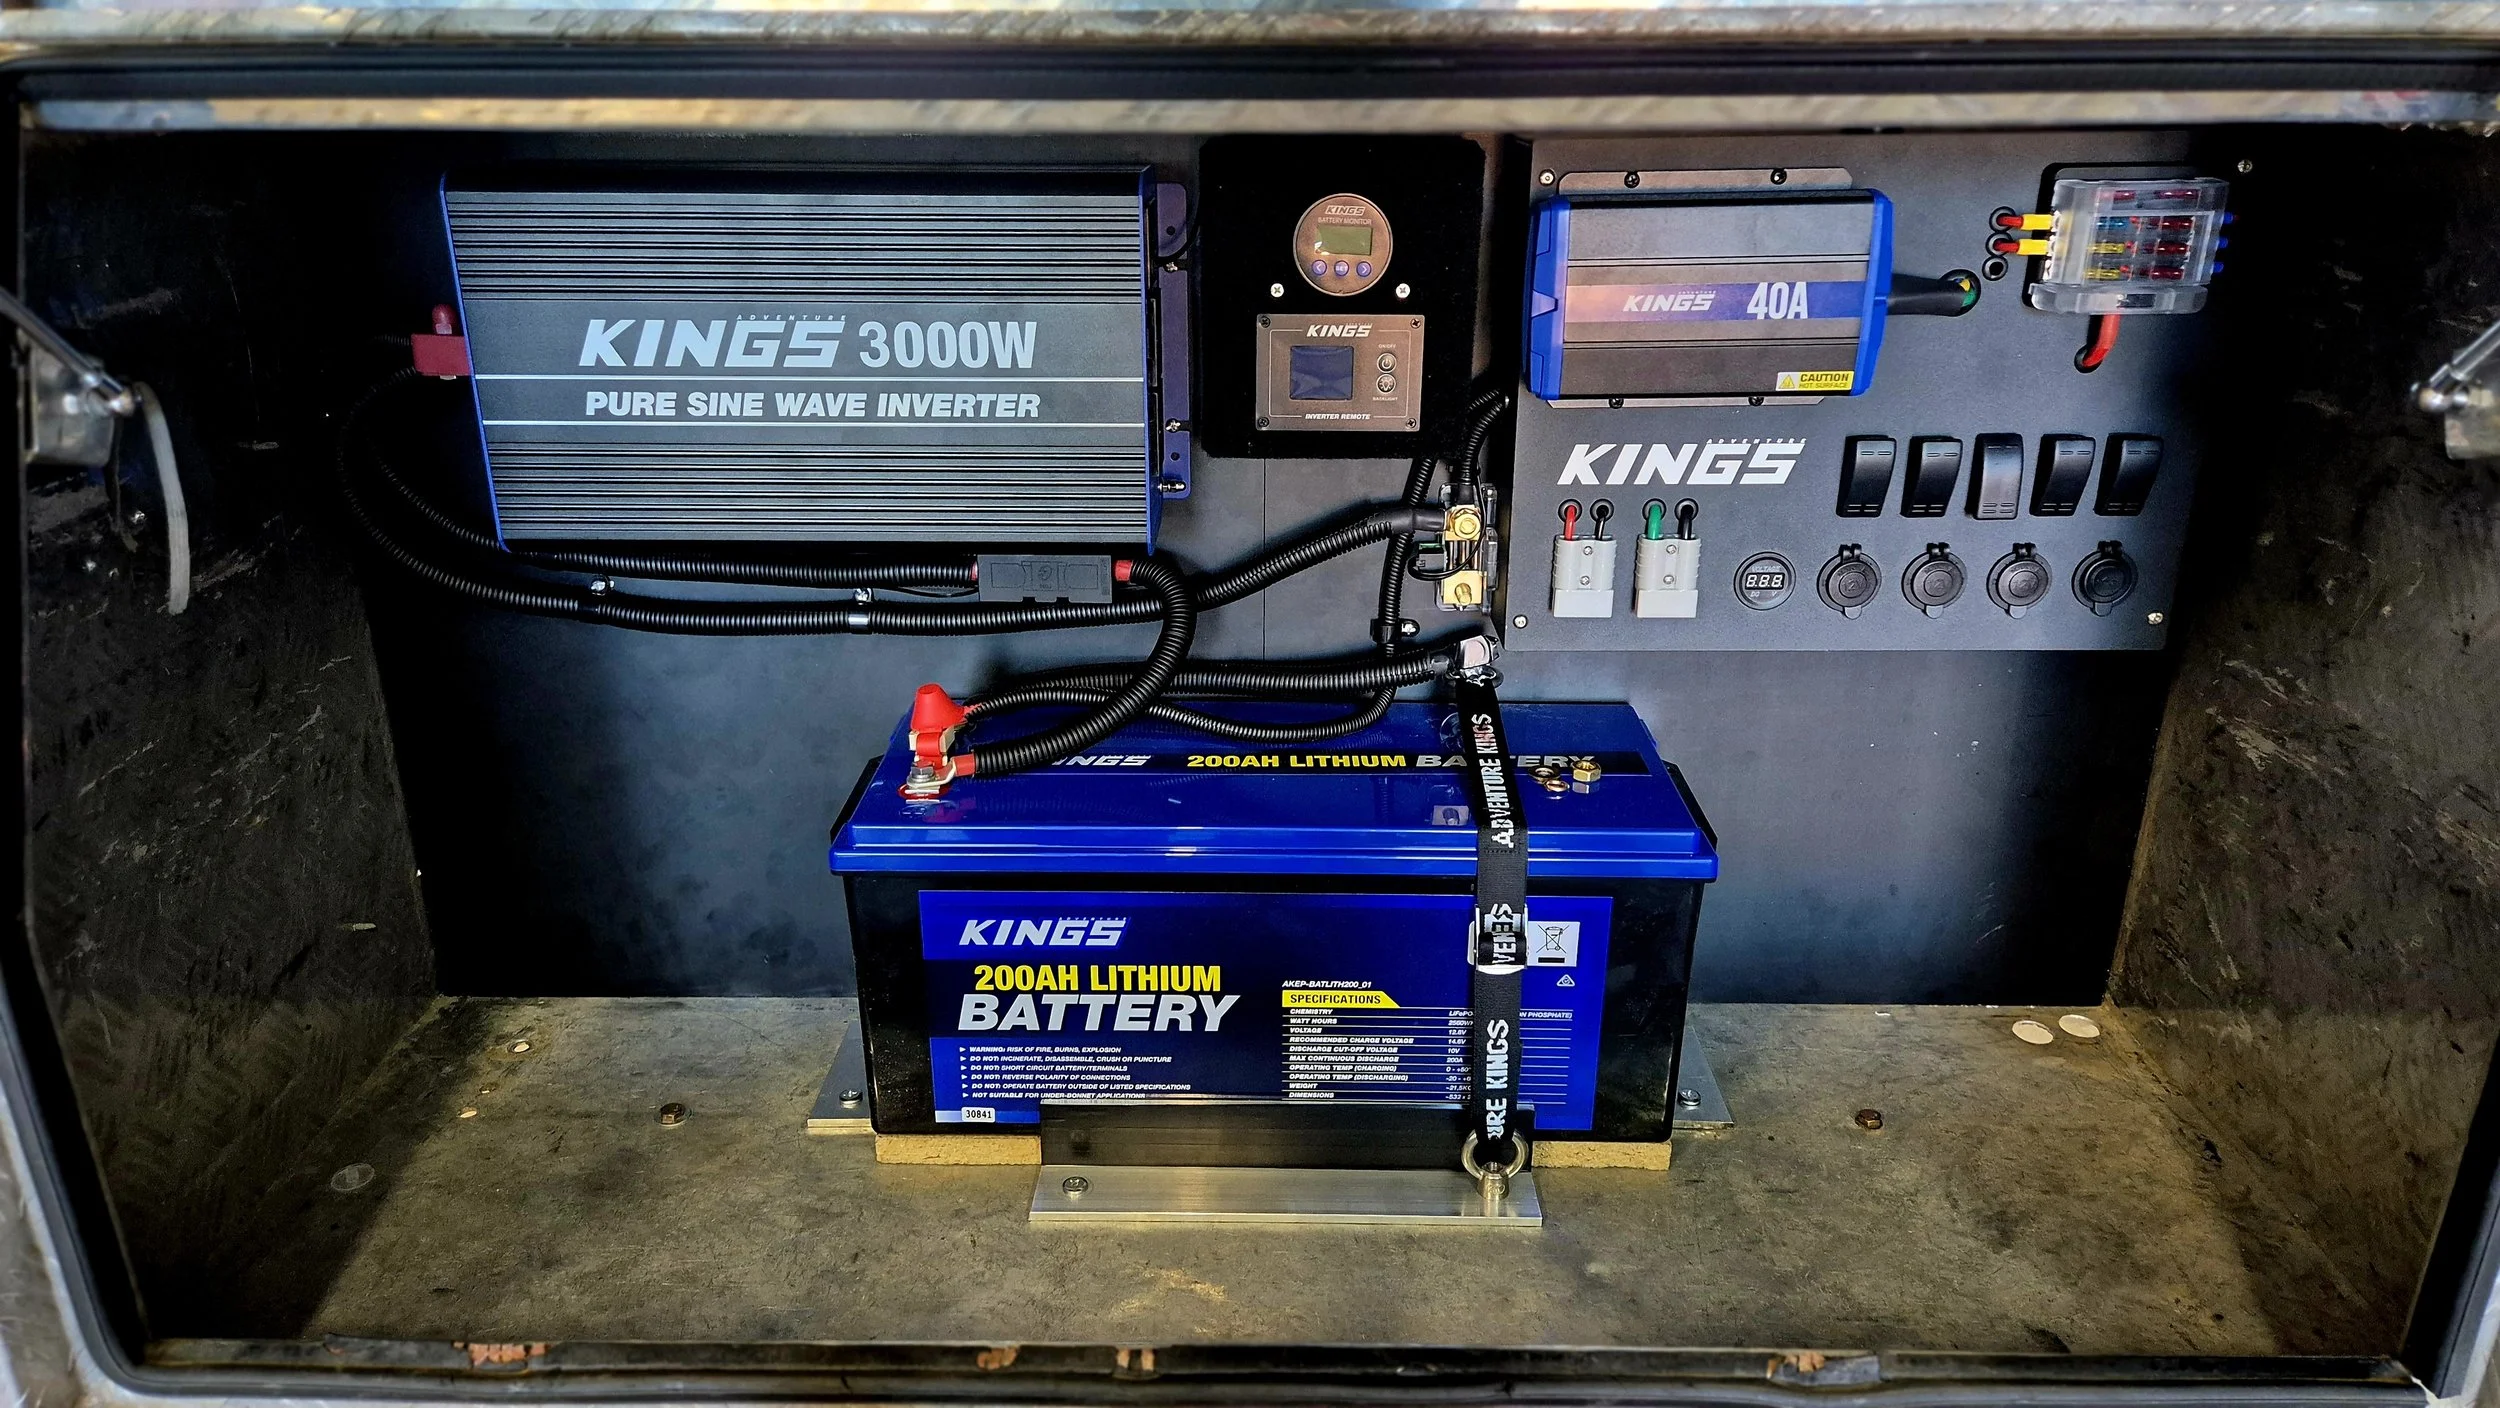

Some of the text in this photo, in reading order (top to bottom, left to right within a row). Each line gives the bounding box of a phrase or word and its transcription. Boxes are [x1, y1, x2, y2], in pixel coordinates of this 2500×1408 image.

[1326, 206, 1365, 215] KINGS
[1622, 294, 1716, 312] KINGS
[1747, 281, 1809, 320] 40A
[1306, 324, 1373, 338] KINGS
[578, 319, 1038, 369] KINGS 3000W
[1800, 373, 1849, 382] CAUTION
[585, 391, 1041, 418] PURE SINE WAVE INVERTER
[1556, 443, 1806, 485] KINGS
[1187, 755, 1595, 768] 200AH LITHIUM BAERY
[1471, 713, 1515, 849] ADVENTURE KINGS
[958, 919, 1127, 946] KINGS
[973, 964, 1221, 992] 200AH LITHIUM
[1281, 980, 1372, 989] AKEP-BATLITH200_01
[1290, 994, 1381, 1005] SPECIFICATIONS
[957, 993, 1241, 1032] BATTERY
[1527, 1011, 1573, 1019] PHOSPHATE)
[970, 1055, 1172, 1063] DO NOT: INCINERATE, DISASSEMBLE, CRUSH OR PUNCTURE
[1289, 1055, 1399, 1063] MAX CONTINUOUS DISCHARGE
[1485, 1019, 1509, 1090] KINGS
[970, 1064, 1128, 1072] DO NOT: SHORT CIRCUIT BATTERY/TERMINALS
[1289, 1064, 1397, 1072] OPERATING TEMP (CHARGING)
[1289, 1073, 1409, 1082] OPERATING TEMP (DISCHARGING)
[965, 1109, 993, 1119] 30841
